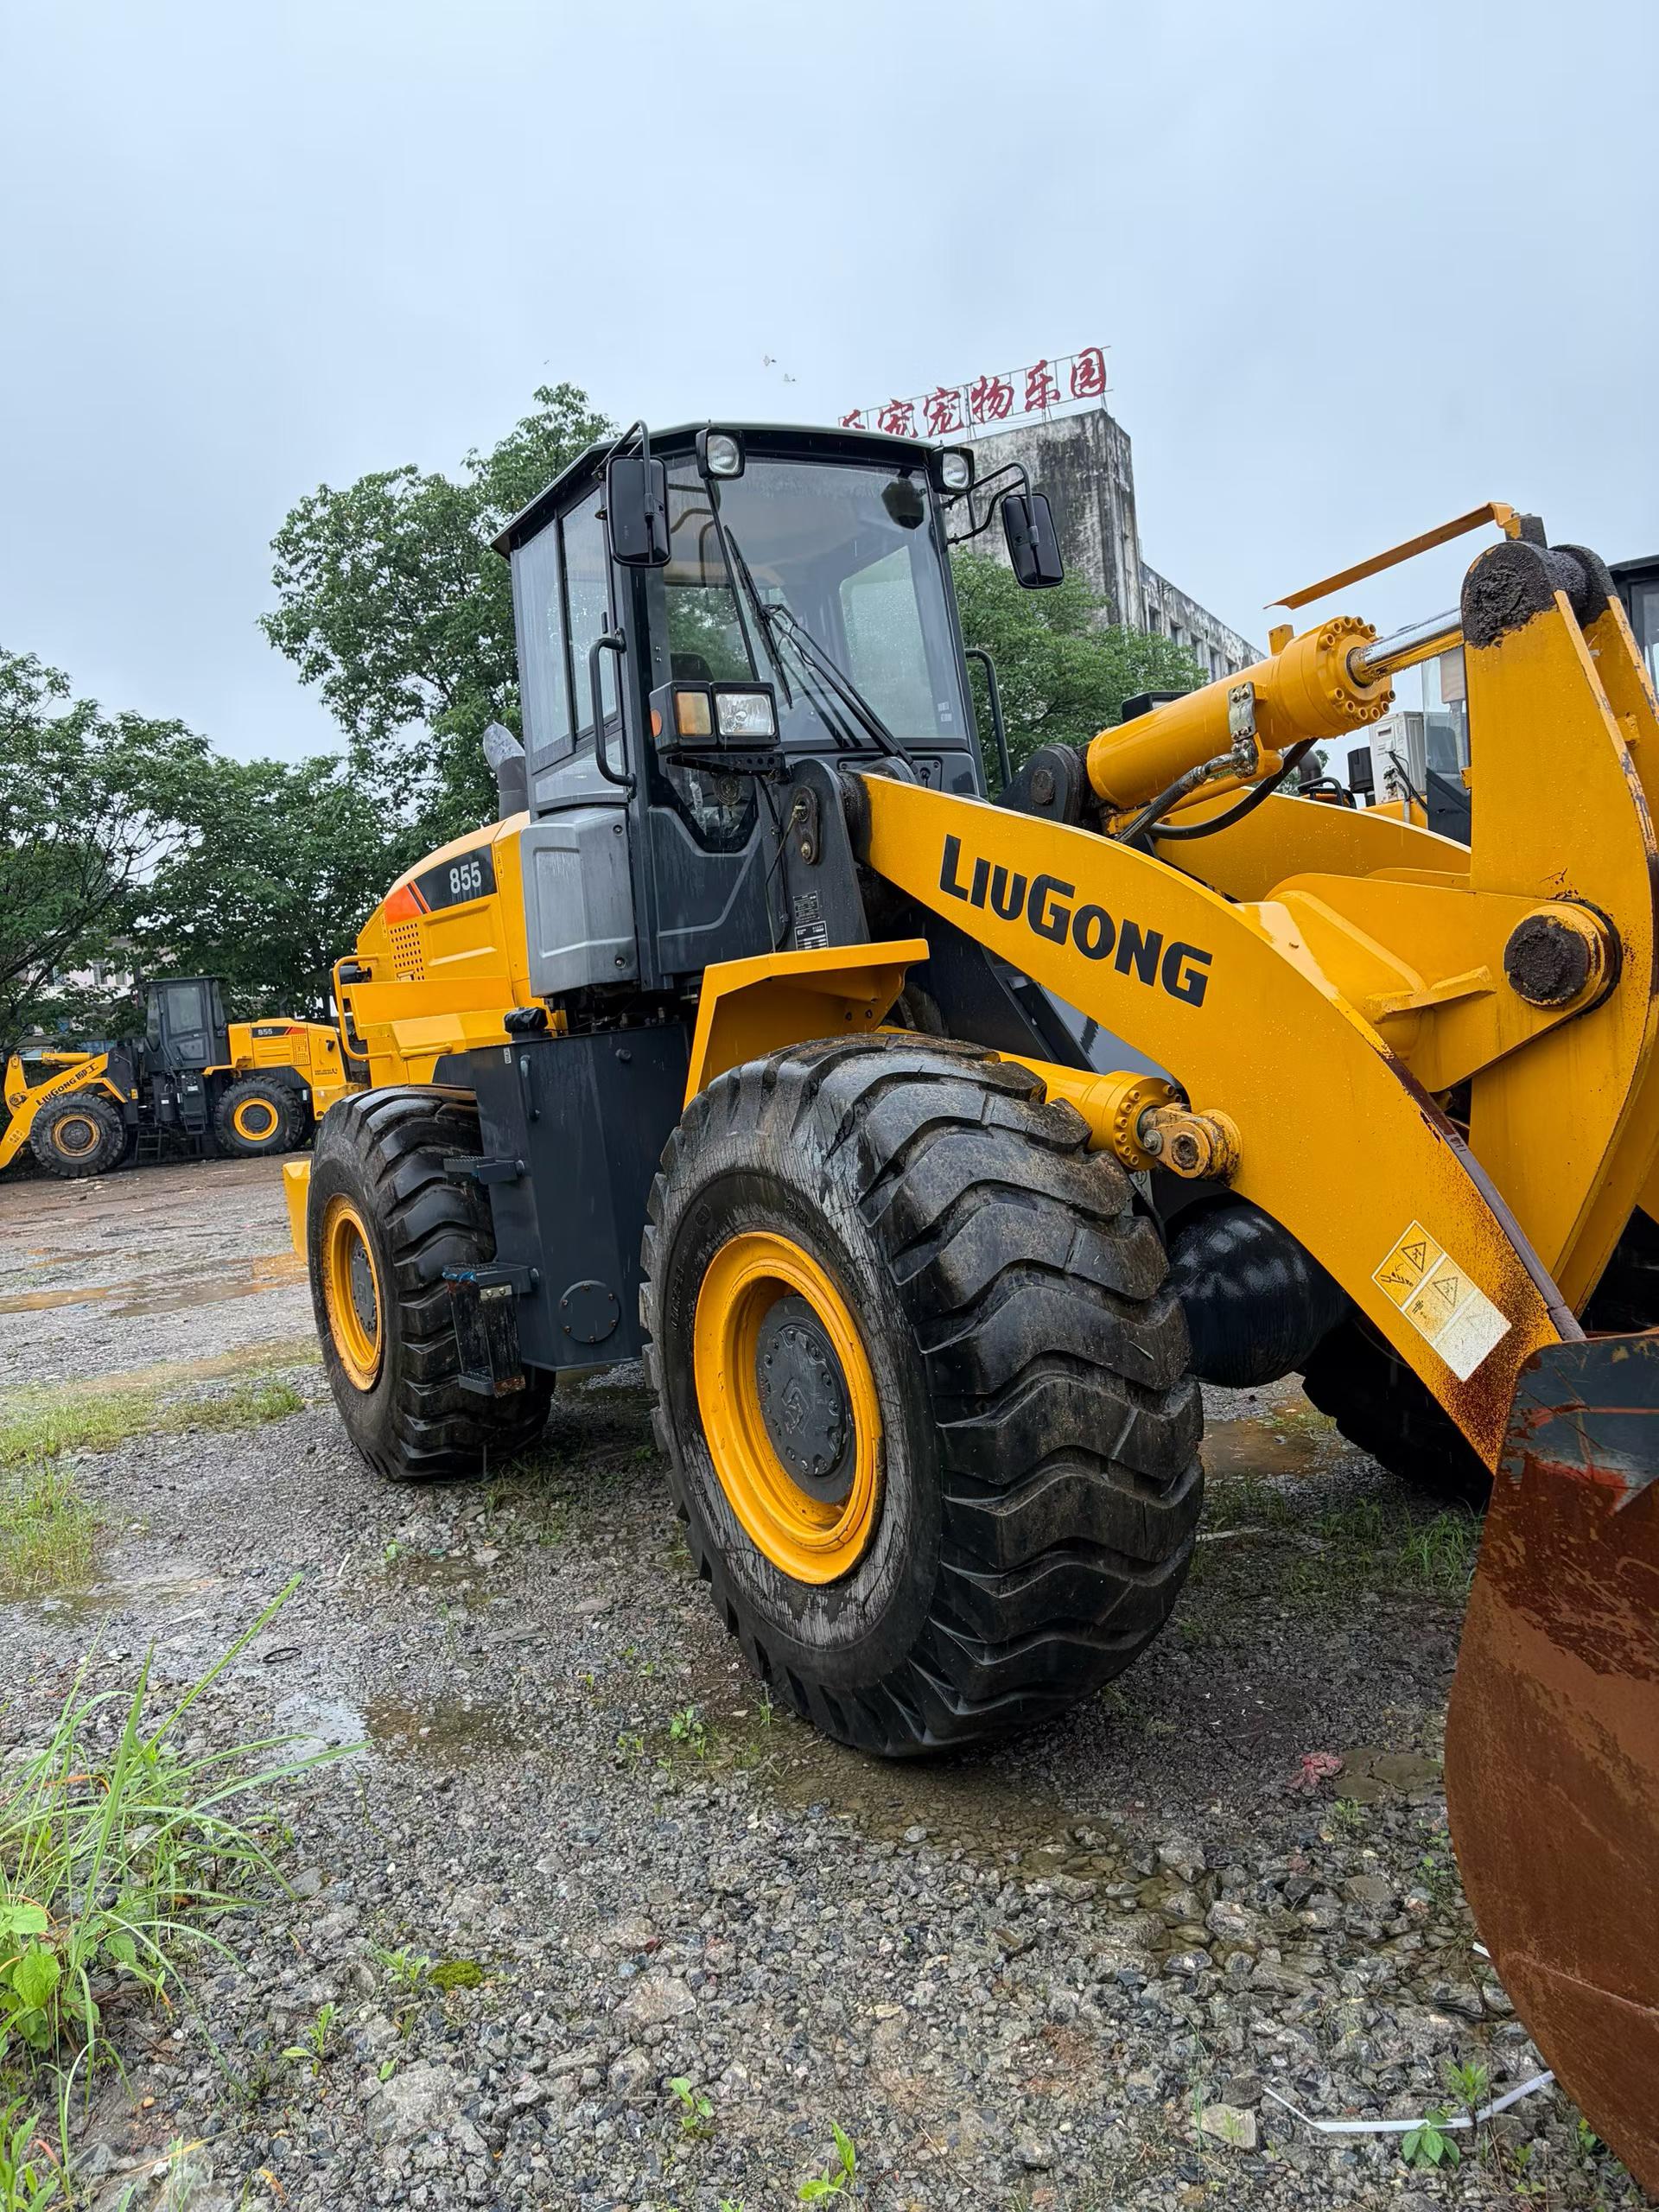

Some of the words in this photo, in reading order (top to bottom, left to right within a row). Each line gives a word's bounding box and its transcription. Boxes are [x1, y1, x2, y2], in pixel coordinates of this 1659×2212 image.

[449, 861, 482, 894] 855
[939, 833, 1214, 1008] LIUGONG
[35, 1077, 77, 1106] LIUGONG
